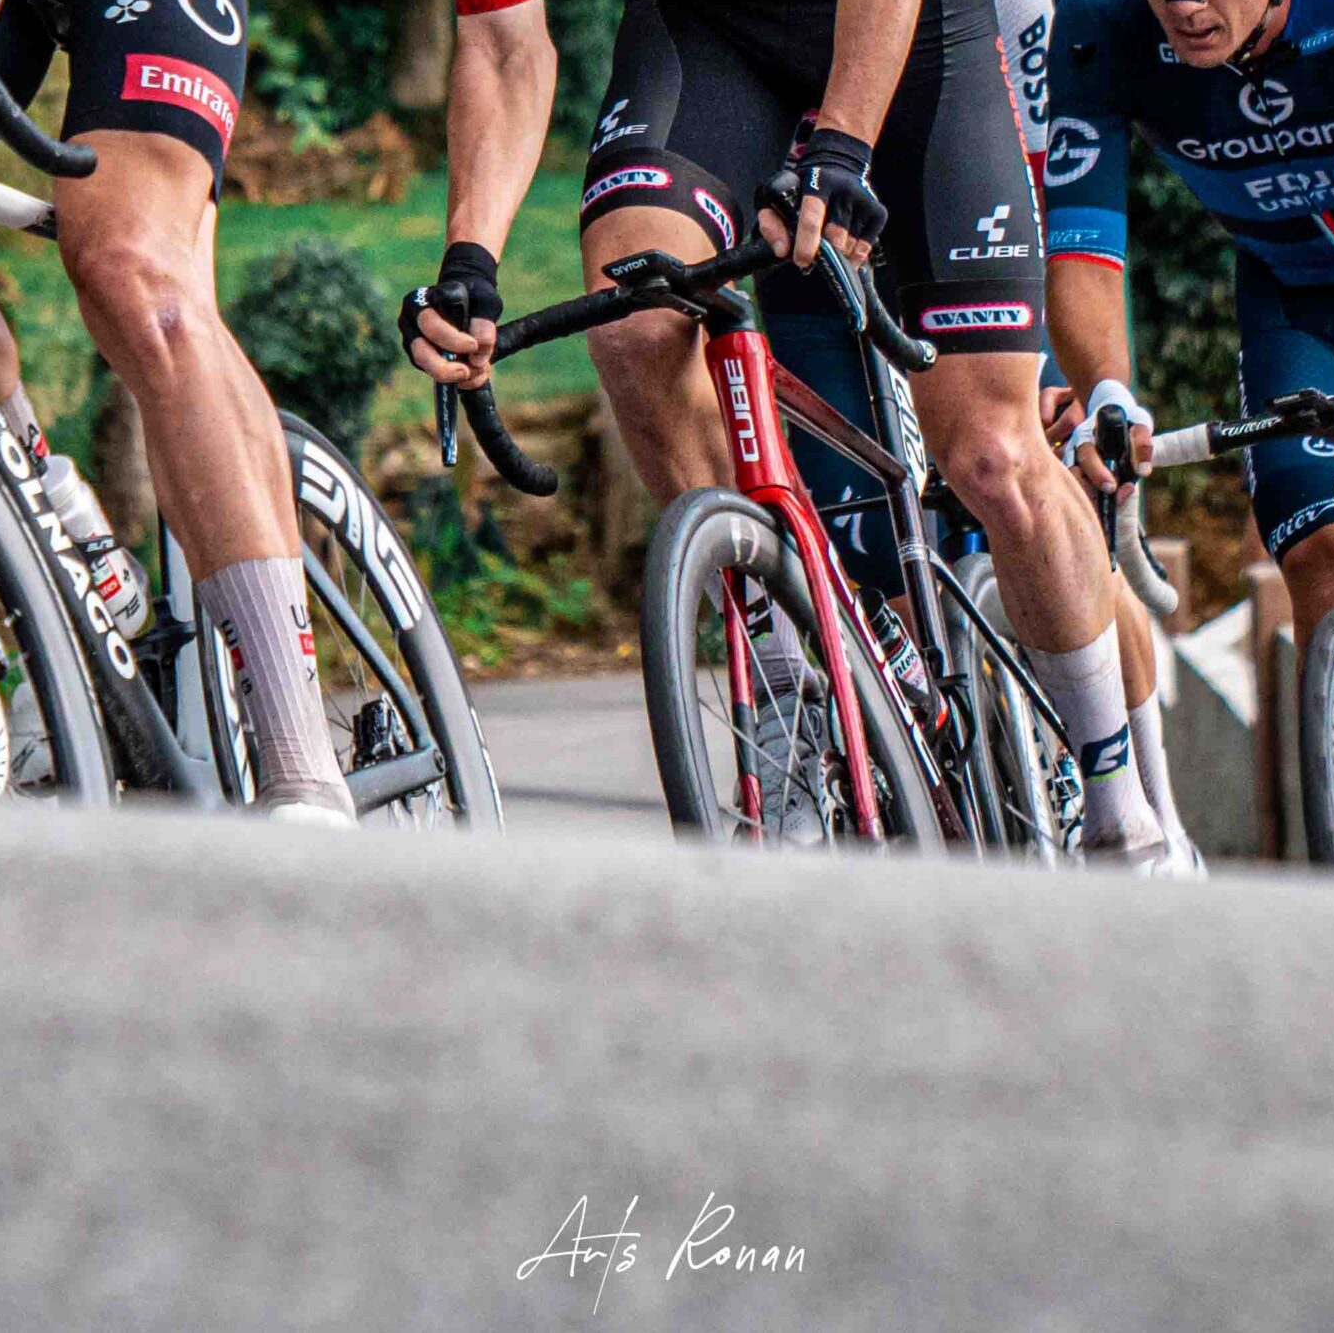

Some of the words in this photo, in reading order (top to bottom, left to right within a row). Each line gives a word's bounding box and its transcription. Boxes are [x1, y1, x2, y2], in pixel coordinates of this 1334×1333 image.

[591, 124, 649, 154] UBE
[948, 244, 1030, 261] CUBE
[931, 309, 1021, 327] WANTY
[724, 358, 760, 462] CUBE
